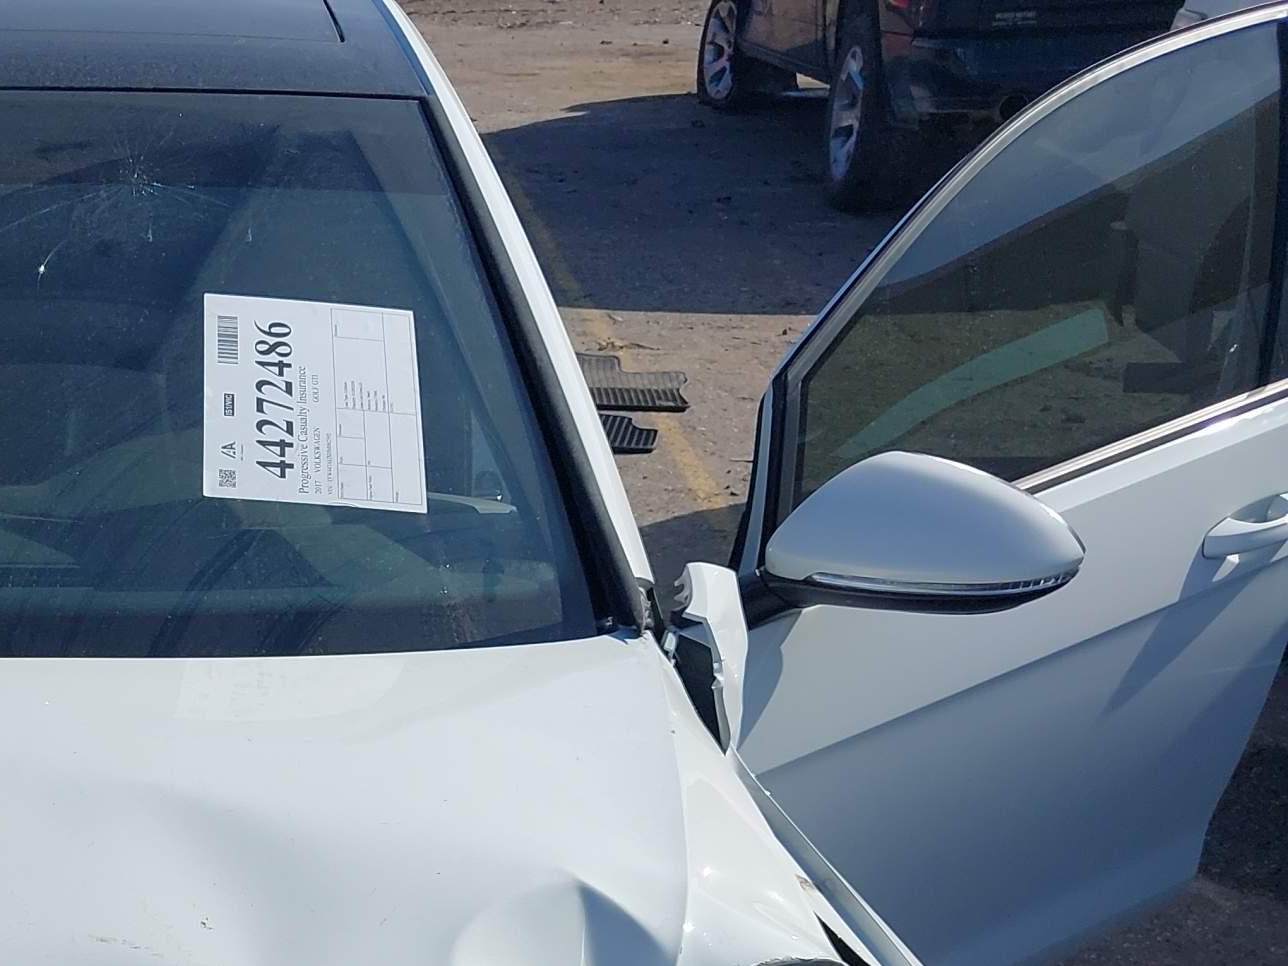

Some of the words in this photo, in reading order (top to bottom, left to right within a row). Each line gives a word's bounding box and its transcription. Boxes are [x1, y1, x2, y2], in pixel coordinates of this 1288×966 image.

[254, 320, 294, 478] 44272486
[296, 366, 309, 405] Insurance
[296, 407, 310, 443] Casualty
[298, 444, 312, 494] Progressive
[313, 427, 322, 473] VOLKSWAGEN
[314, 480, 322, 494] 2017
